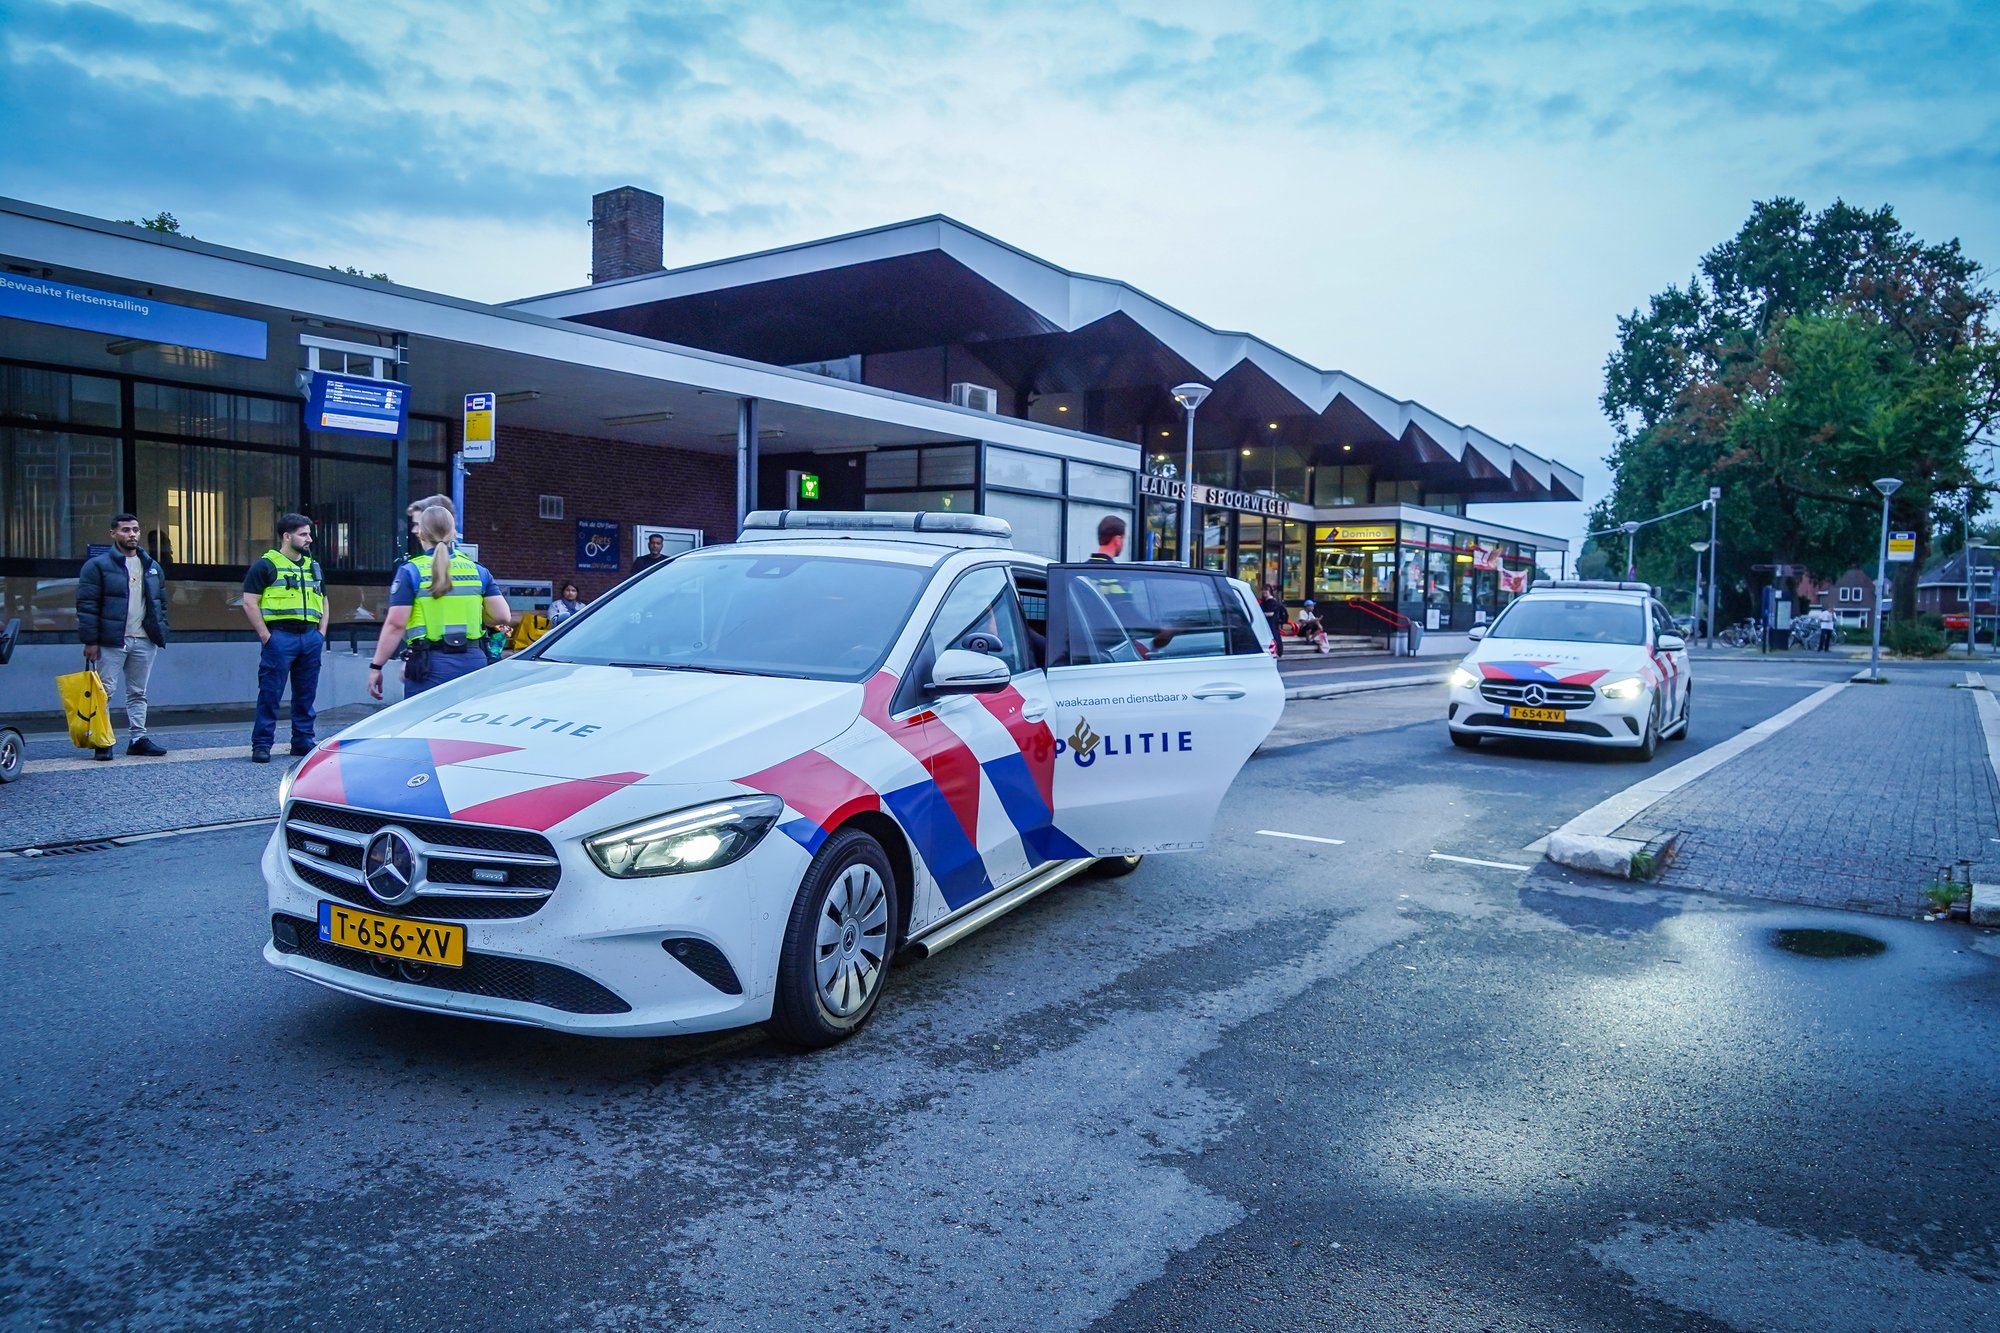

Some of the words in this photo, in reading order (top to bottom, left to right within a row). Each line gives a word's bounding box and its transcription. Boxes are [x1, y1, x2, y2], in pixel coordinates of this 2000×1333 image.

[0, 278, 62, 298] Bewaakte
[65, 289, 149, 316] fietsenstalling
[1208, 489, 1290, 515] SPOORWEGEN
[1342, 528, 1388, 538] Domino's
[1056, 696, 1110, 708] waakzaam
[1112, 697, 1125, 705] en
[1127, 693, 1179, 704] dienstbaar
[1512, 707, 1560, 720] T-654-XV
[433, 712, 602, 738] POLITIE
[1055, 731, 1192, 767] POLITIE
[321, 925, 330, 935] NL
[337, 911, 451, 959] T-656-XV
